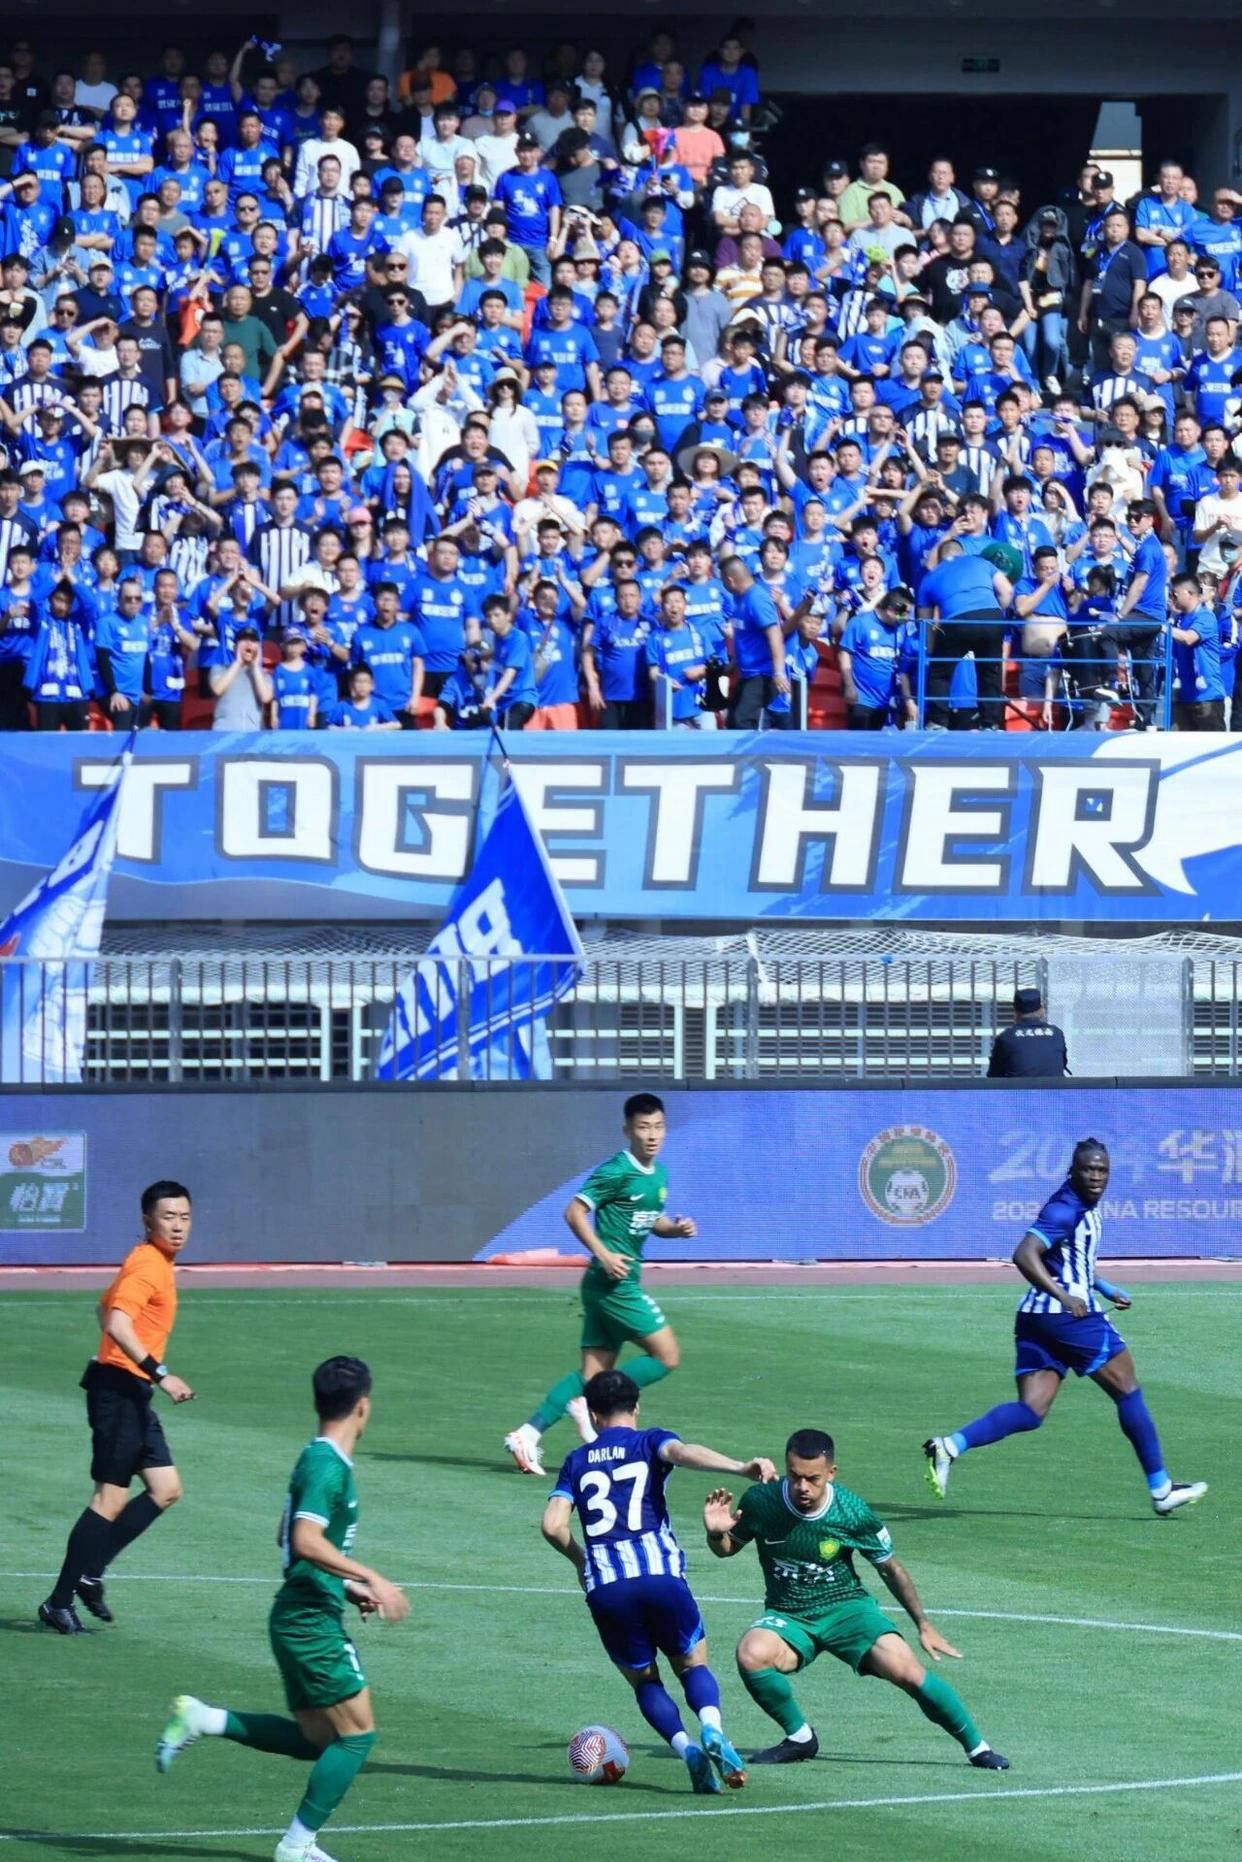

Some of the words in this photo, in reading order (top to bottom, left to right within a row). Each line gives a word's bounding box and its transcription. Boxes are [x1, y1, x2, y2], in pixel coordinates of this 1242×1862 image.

[74, 756, 1162, 895] TOGETHER
[587, 1446, 626, 1464] DARLAN
[580, 1460, 649, 1537] 37
